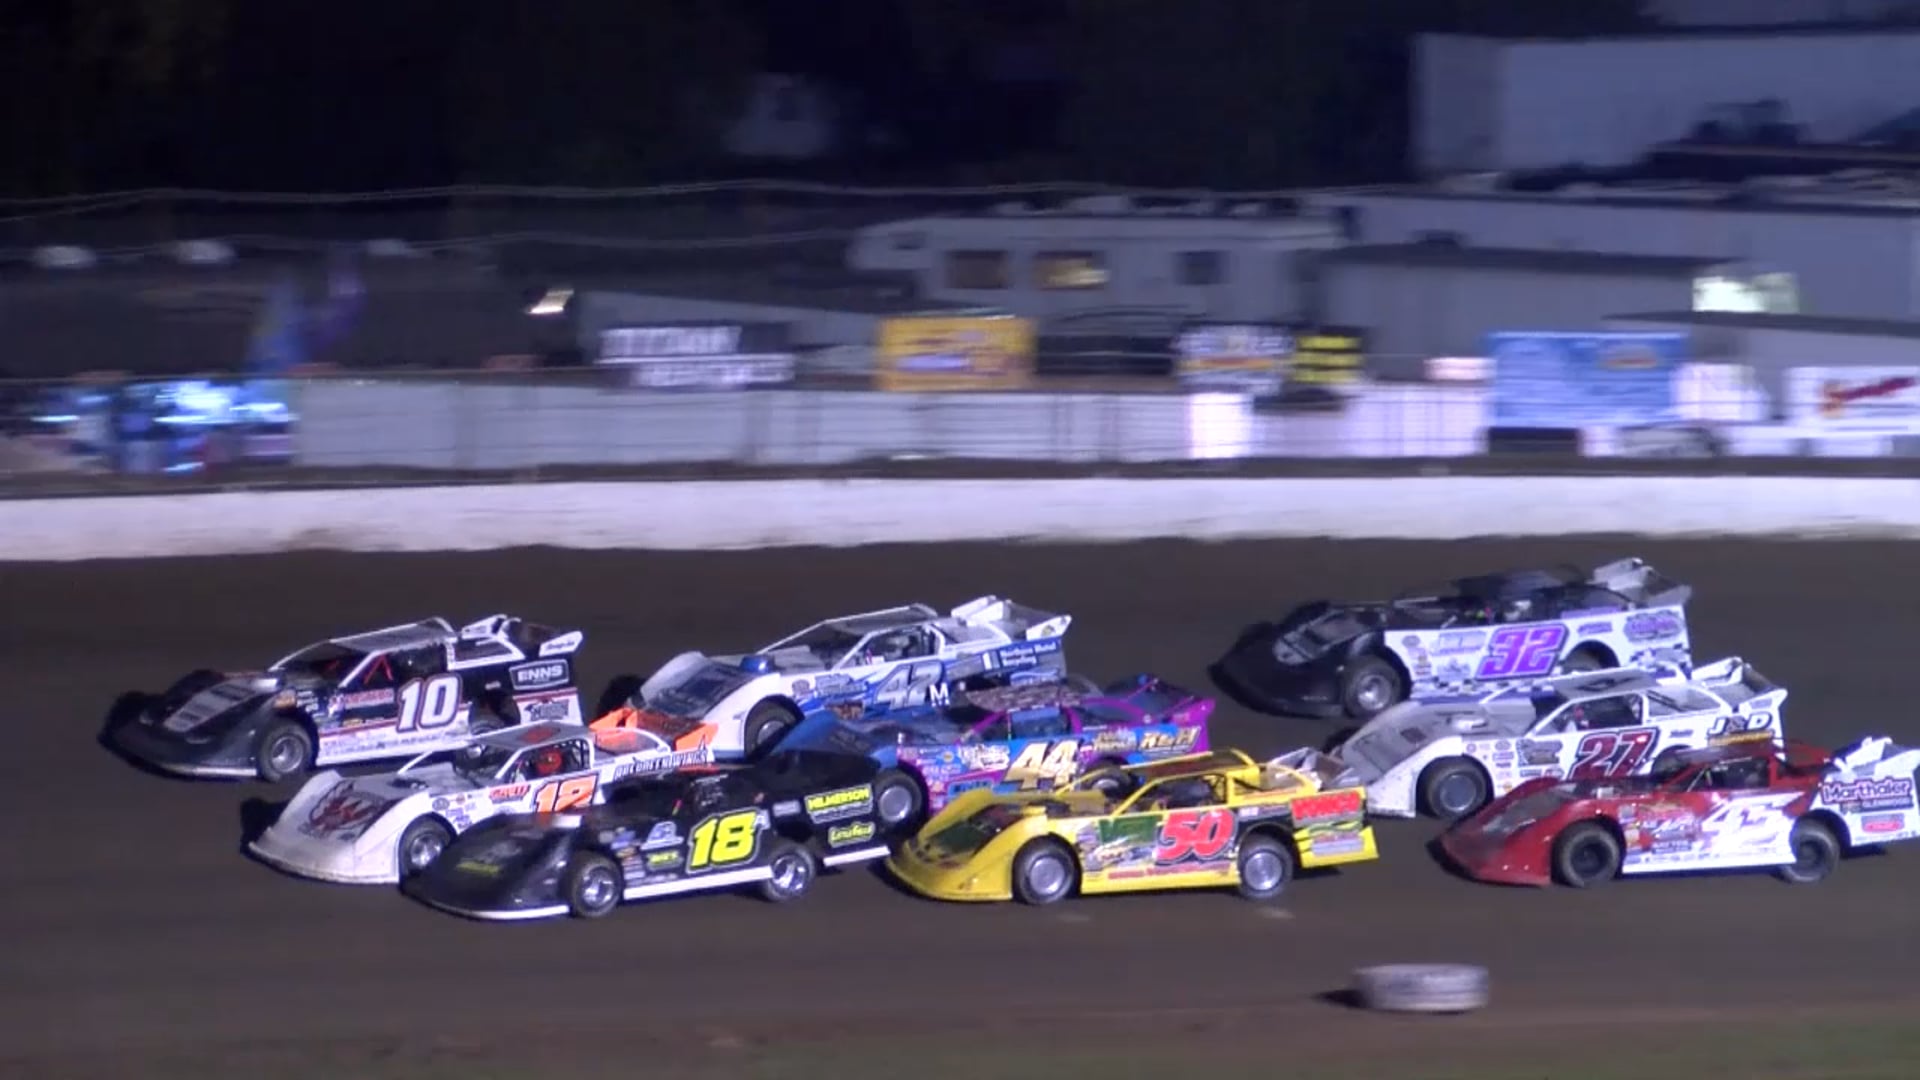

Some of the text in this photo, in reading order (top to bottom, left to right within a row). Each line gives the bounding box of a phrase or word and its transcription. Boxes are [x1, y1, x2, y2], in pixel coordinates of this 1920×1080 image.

[517, 664, 564, 683] ENNS
[1474, 624, 1570, 681] 32
[397, 674, 462, 732] 10
[1003, 739, 1081, 792] 44
[1568, 727, 1659, 782] 27
[1821, 777, 1911, 804] Marthaler
[689, 810, 758, 870] 18
[1156, 808, 1235, 865] 50
